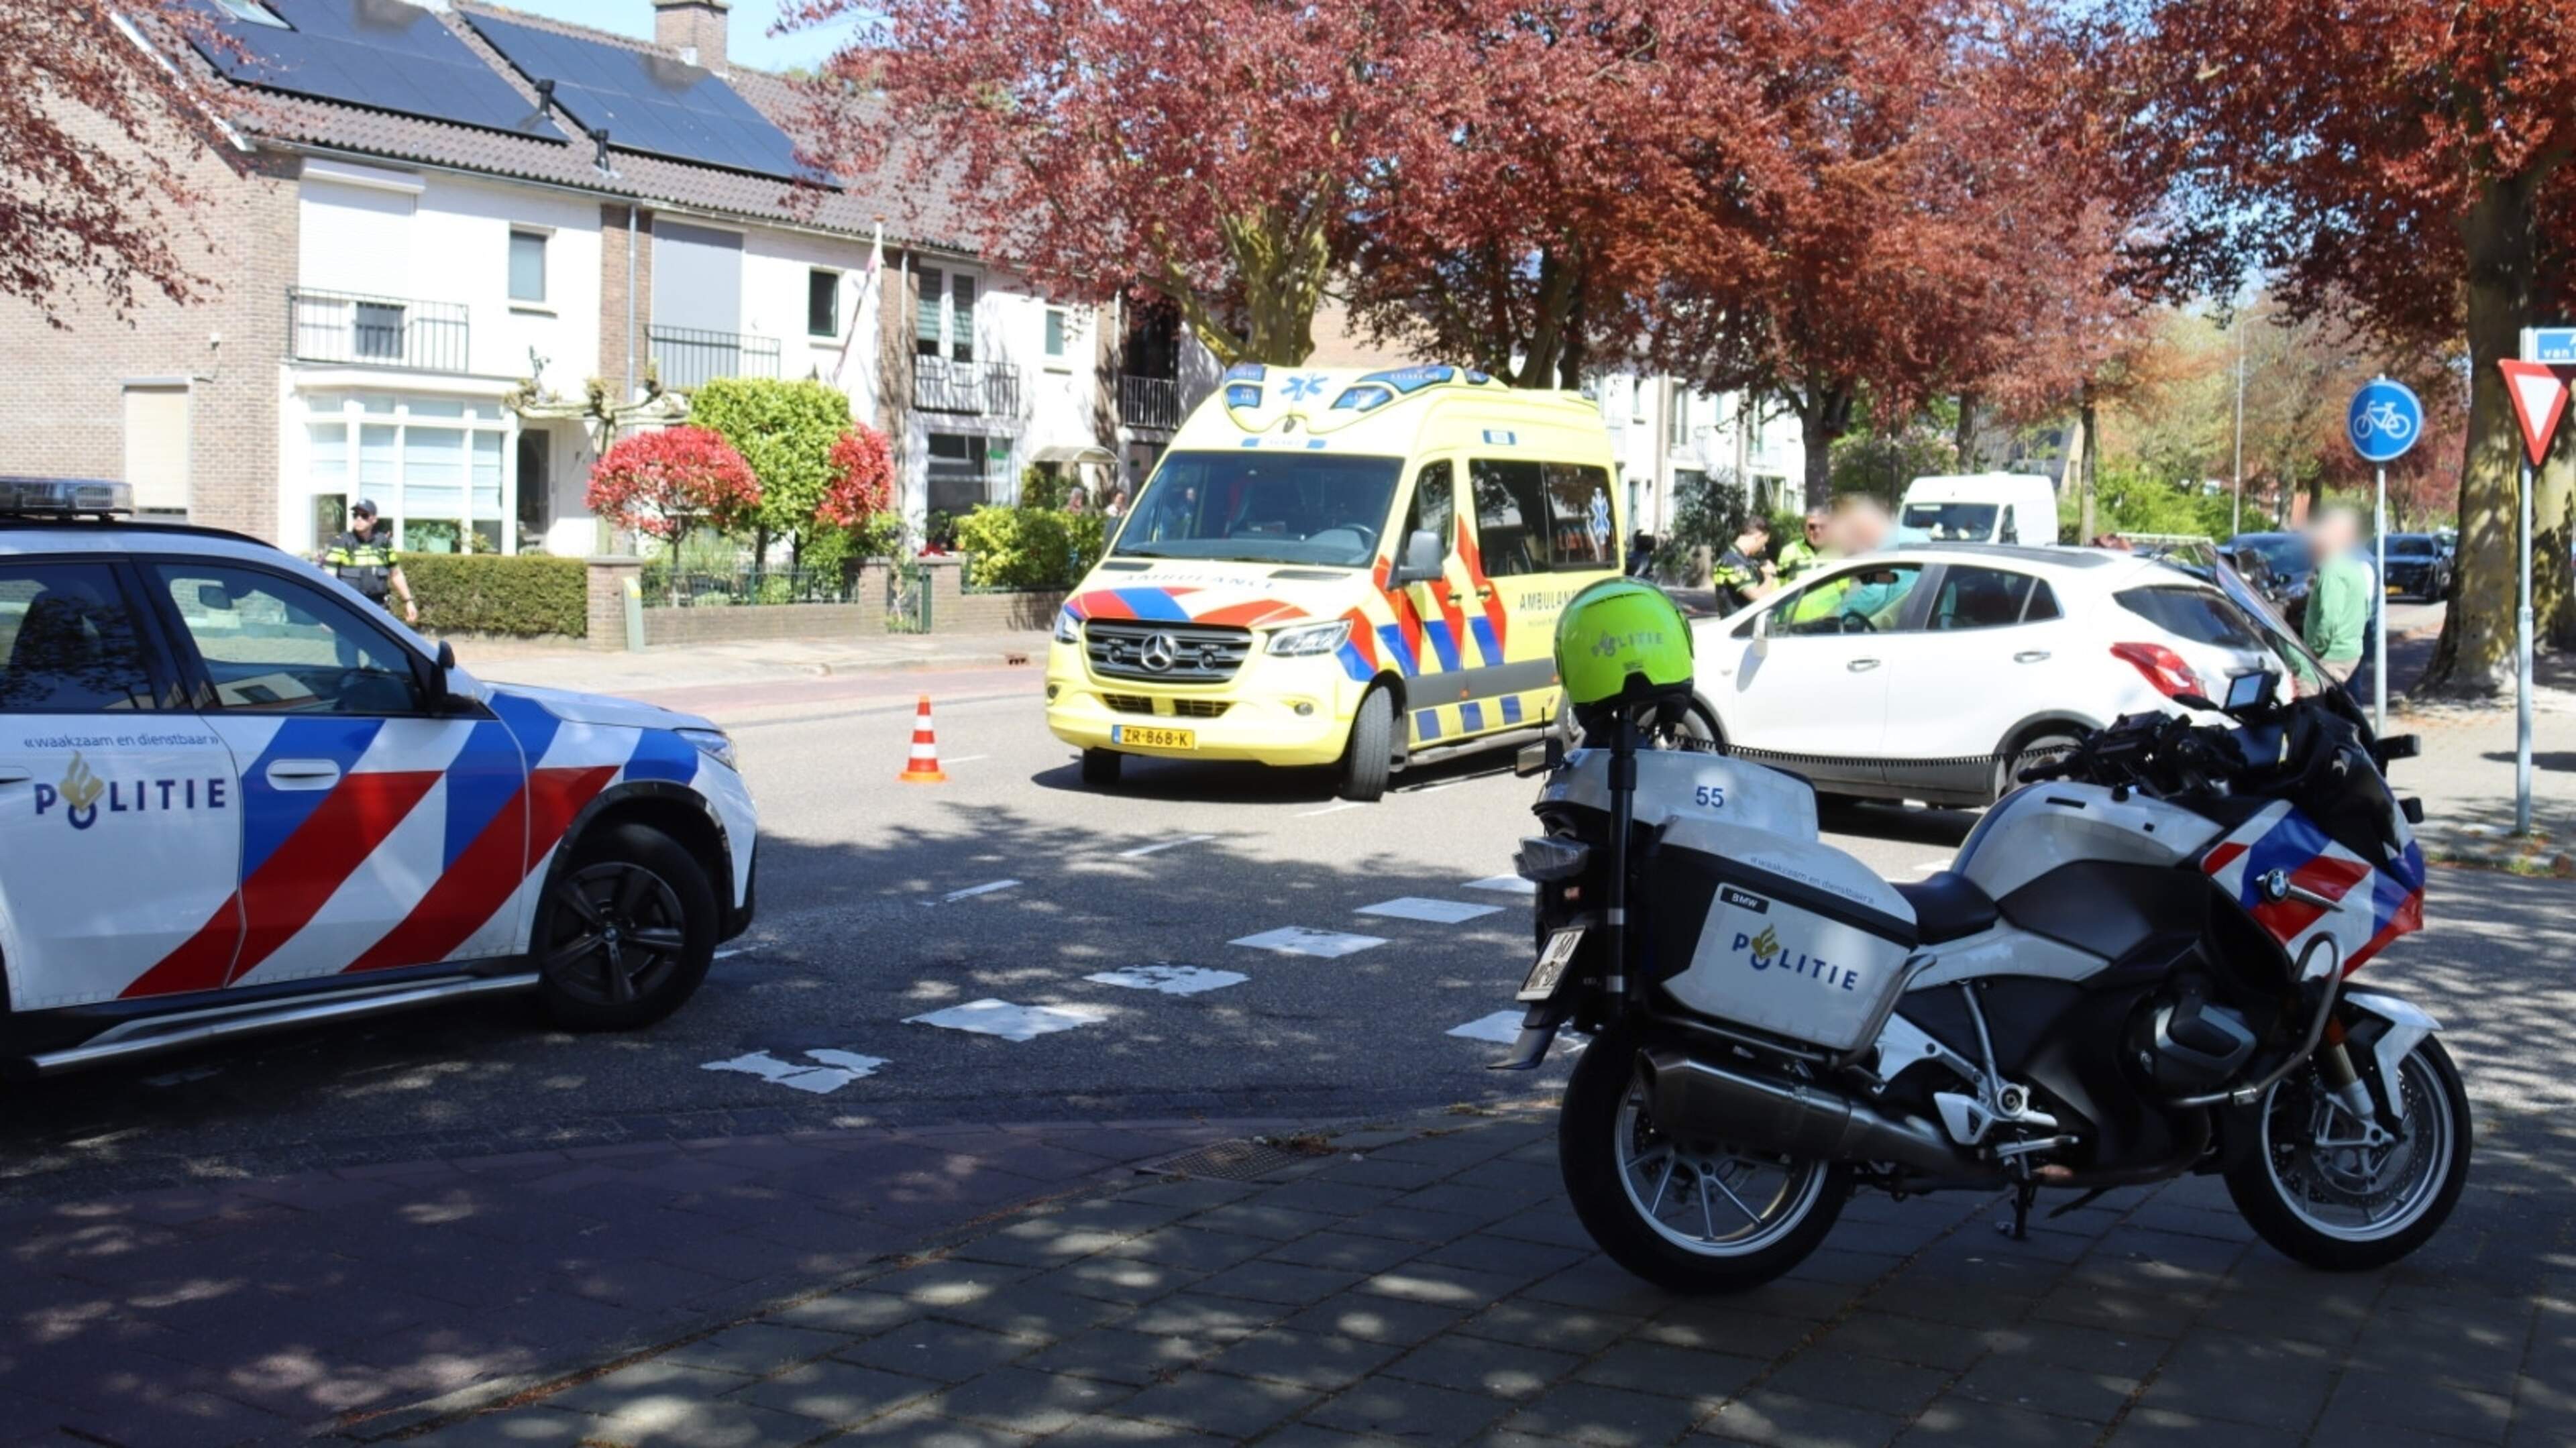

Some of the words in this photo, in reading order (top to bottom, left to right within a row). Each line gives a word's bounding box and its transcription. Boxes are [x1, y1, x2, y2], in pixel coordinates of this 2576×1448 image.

[117, 736, 135, 746] en
[34, 778, 226, 830] POLITIE
[1695, 785, 1725, 808] 55
[1808, 877, 1820, 885] en
[1731, 893, 1758, 908] BMW
[1731, 932, 1859, 991] POLITIE
